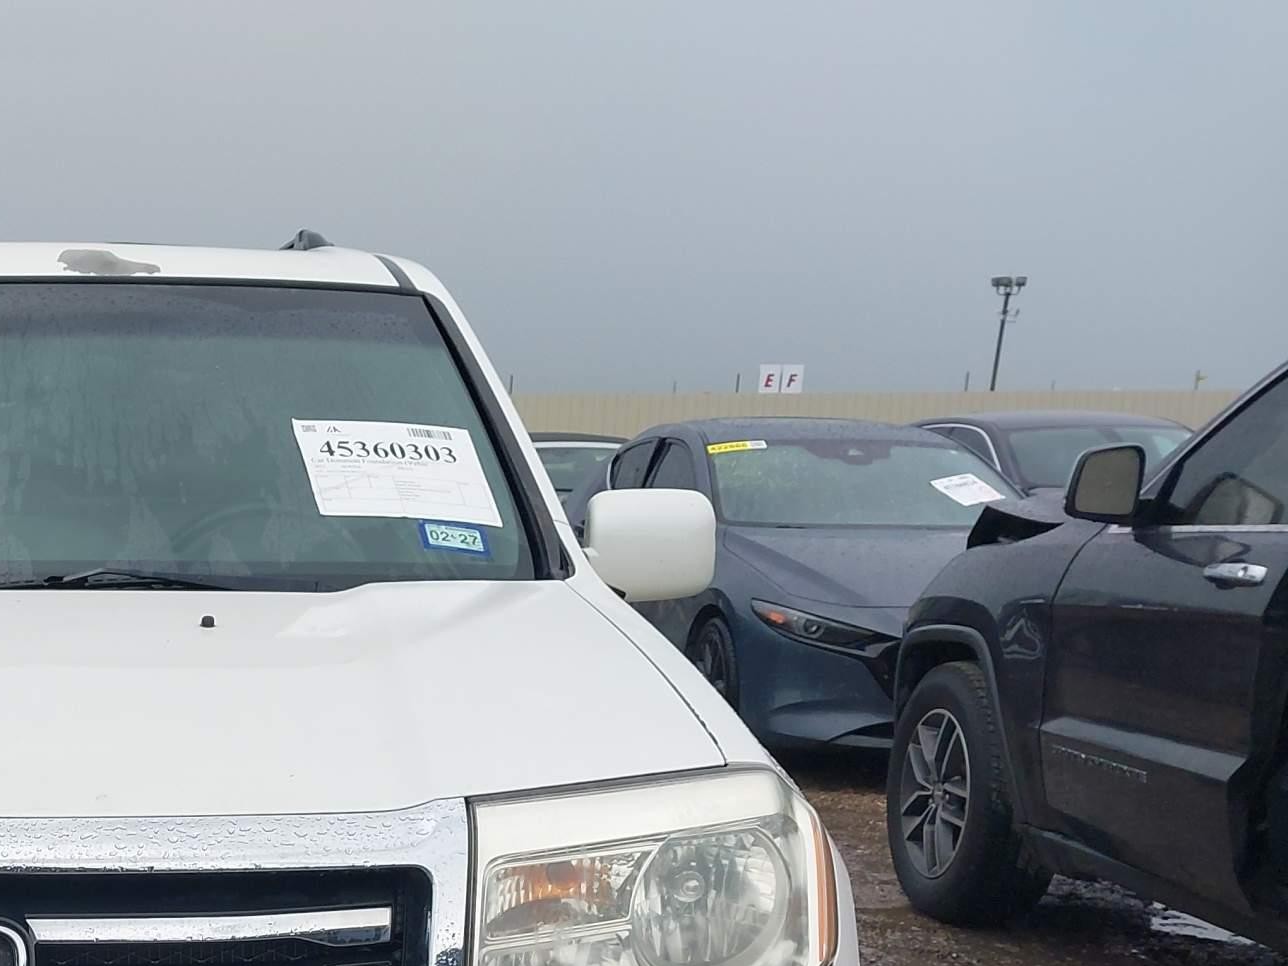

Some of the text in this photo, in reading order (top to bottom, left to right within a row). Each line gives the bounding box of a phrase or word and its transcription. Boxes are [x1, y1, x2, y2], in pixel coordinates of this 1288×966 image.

[764, 373, 775, 388] E
[786, 373, 798, 388] F
[319, 440, 457, 464] 45360303
